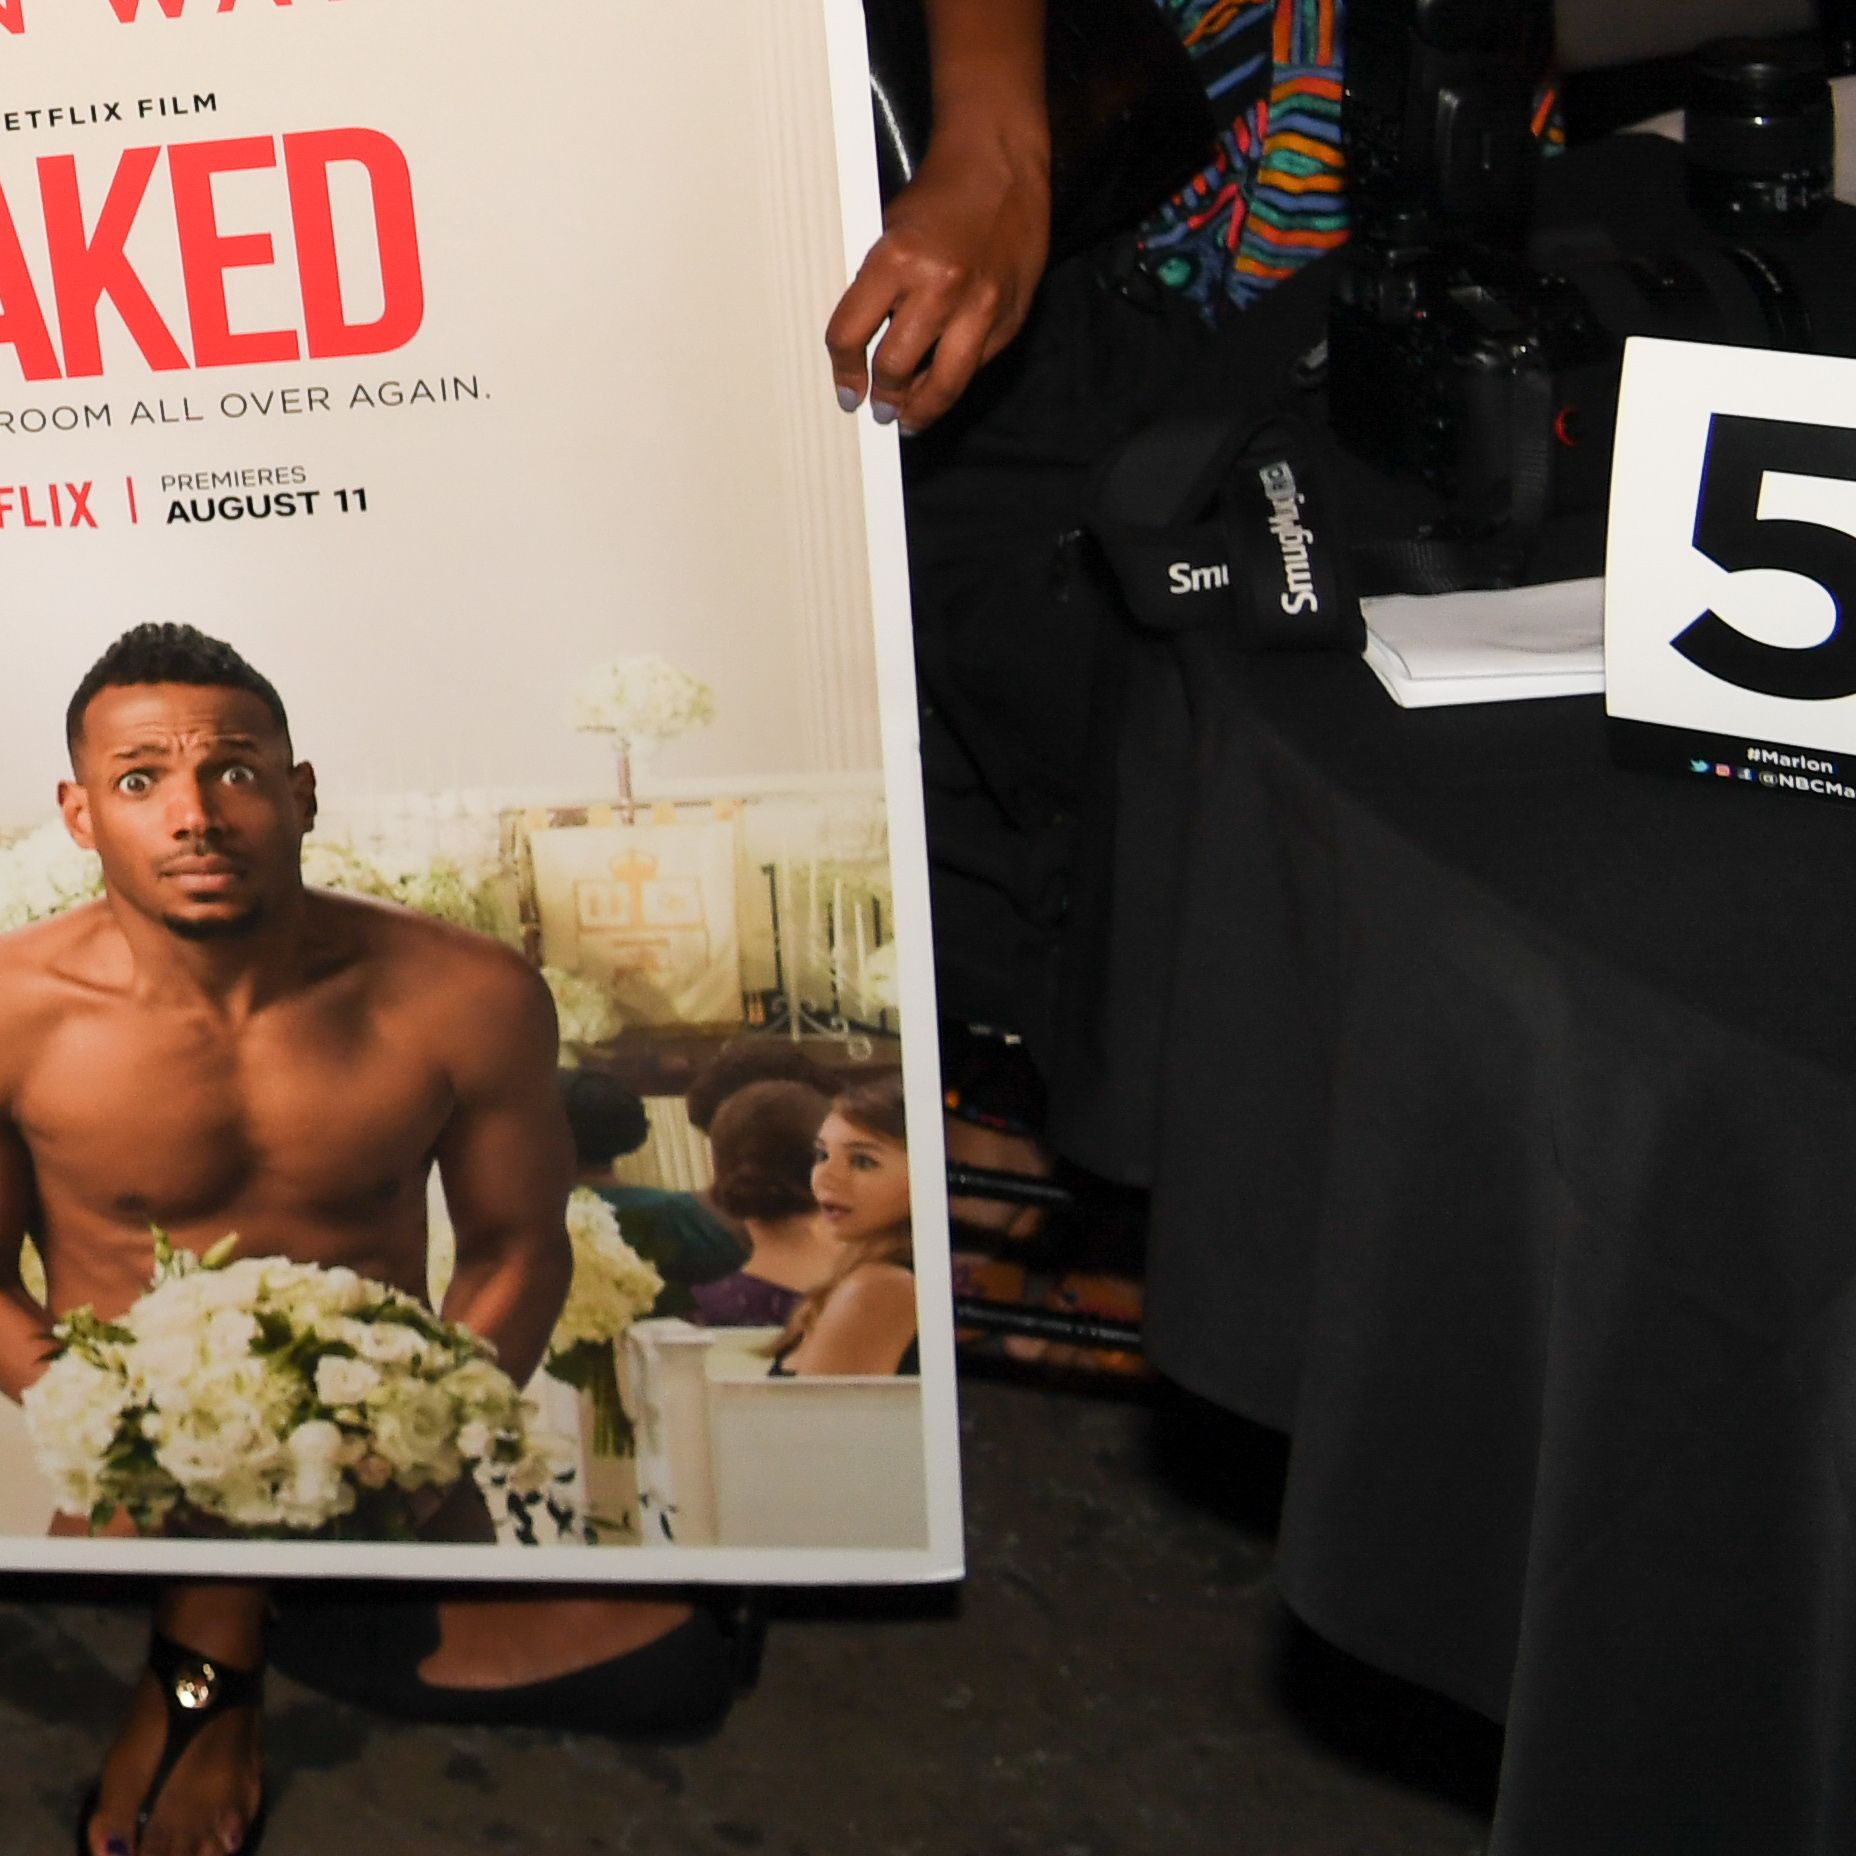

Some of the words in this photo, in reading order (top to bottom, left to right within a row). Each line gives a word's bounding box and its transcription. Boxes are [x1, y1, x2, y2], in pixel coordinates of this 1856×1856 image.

[137, 93, 217, 118] FILM
[130, 398, 204, 425] ALL
[219, 389, 330, 418] OVER
[350, 375, 491, 408] AGAIN.
[161, 466, 307, 492] PREMIERES
[166, 490, 320, 524] AUGUST
[333, 487, 367, 513] 11
[1746, 746, 1835, 775] #Marlon
